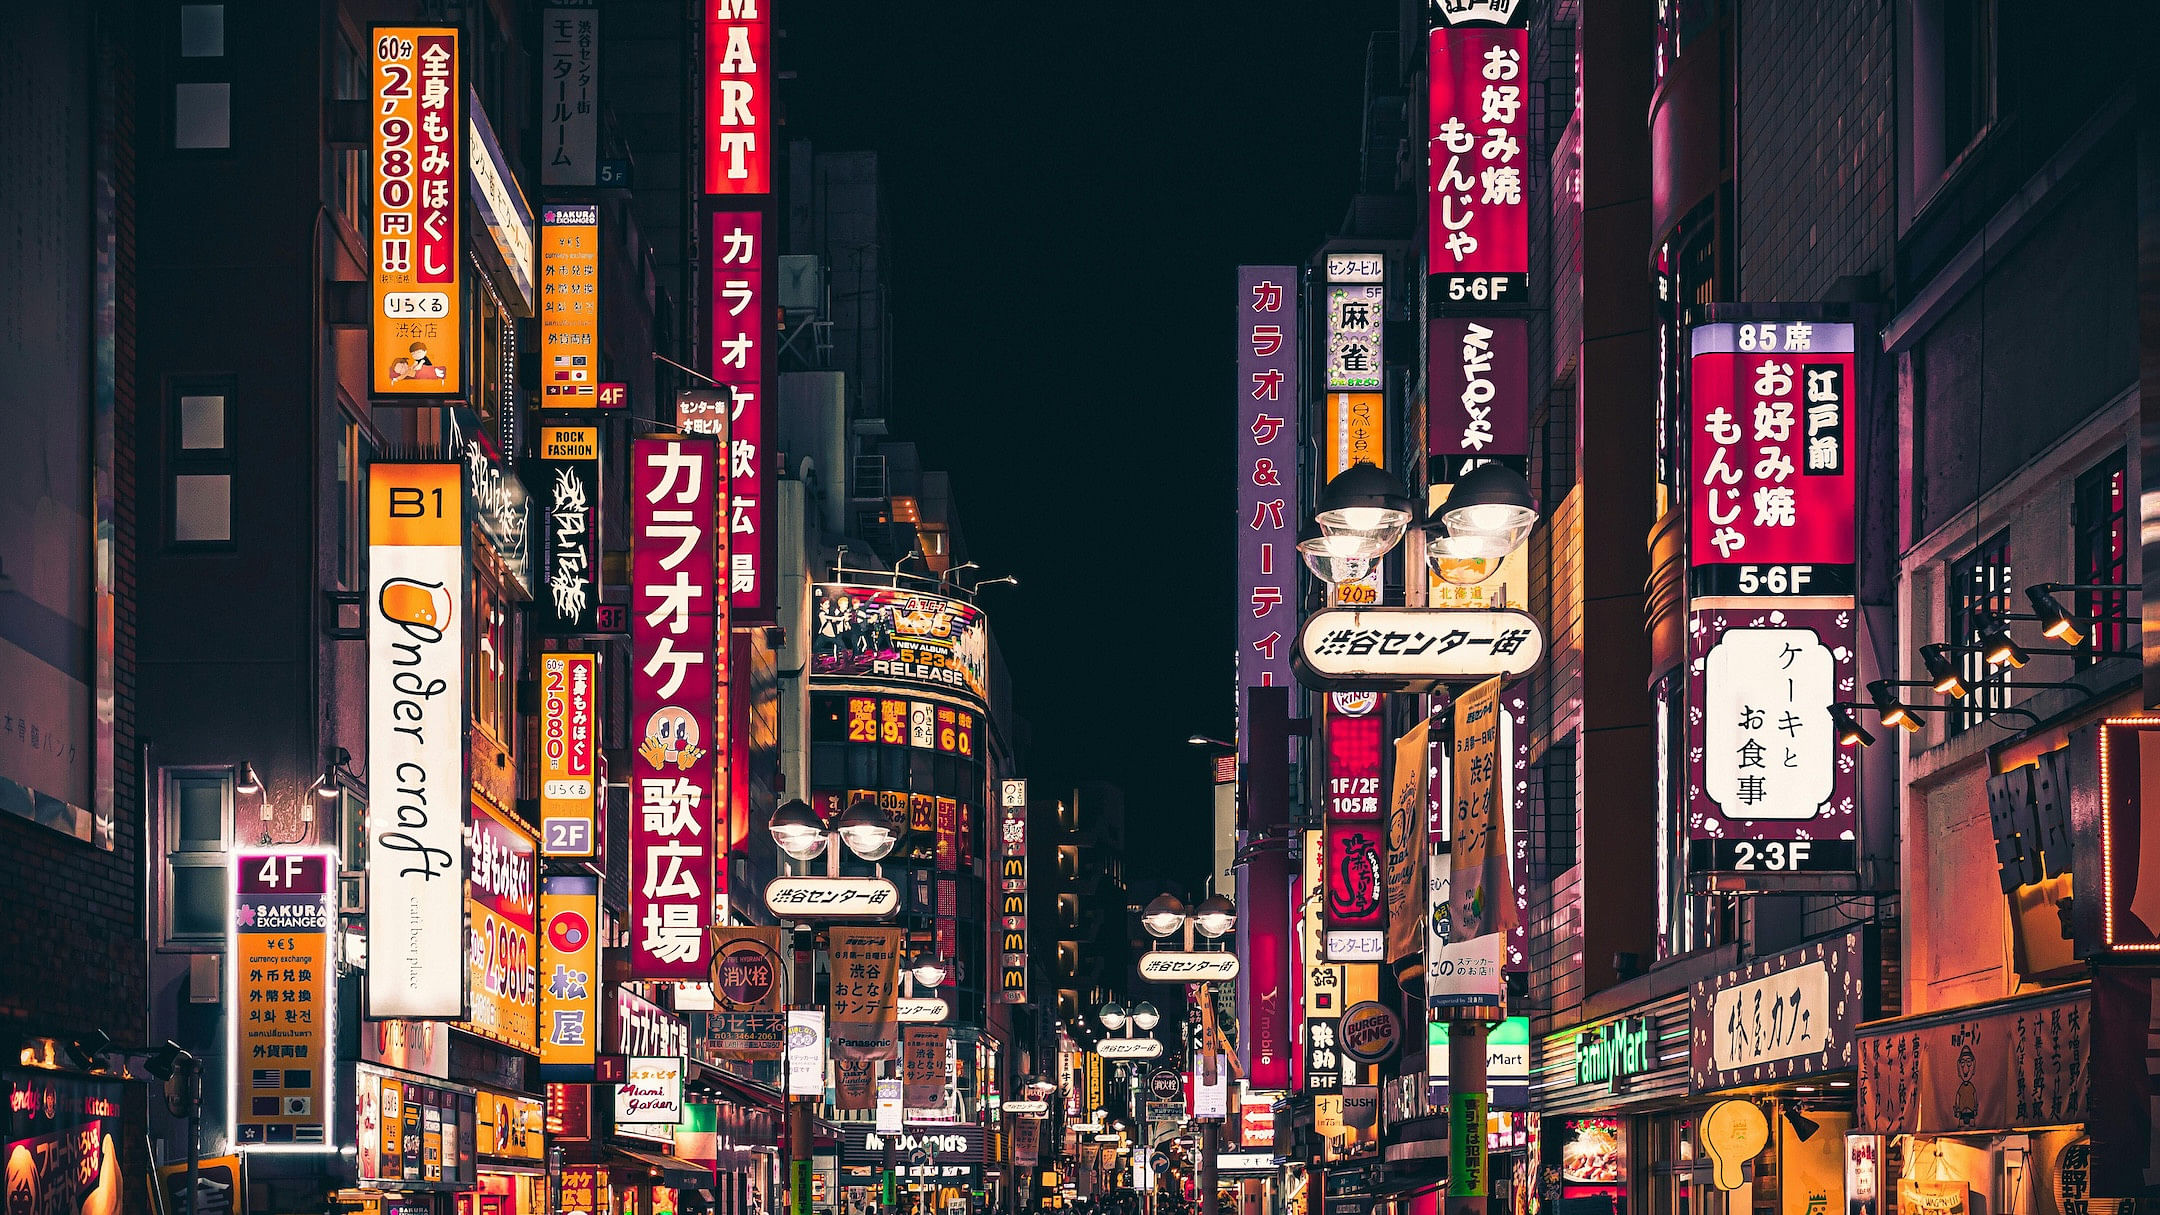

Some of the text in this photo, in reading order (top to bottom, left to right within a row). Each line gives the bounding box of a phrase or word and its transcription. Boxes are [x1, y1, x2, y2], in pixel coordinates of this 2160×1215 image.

[378, 37, 412, 60] 60分
[577, 20, 591, 115] 渋谷センター街
[551, 20, 573, 167] モニタールーム
[1481, 45, 1521, 205] お好み焼
[421, 43, 450, 274] 全身もみほぐし
[1438, 116, 1478, 262] もんじゃ
[1328, 261, 1381, 276] センタービル
[1366, 288, 1382, 298] 5F
[389, 298, 443, 313] りらくる
[395, 323, 438, 338] 渋谷店
[1341, 302, 1370, 371] 麻雀
[600, 388, 624, 404] 4F
[680, 401, 725, 414] センター街
[1808, 370, 1838, 470] 江戸前
[555, 431, 584, 443] ROCK
[1753, 360, 1795, 527] お好み焼
[548, 445, 592, 456] FASHION
[1703, 407, 1746, 558] もんじゃ
[389, 488, 442, 518] B1
[1439, 587, 1483, 600] 北海道
[602, 610, 622, 628] 3F
[897, 641, 948, 654] NEW ALBUM
[1314, 629, 1532, 656] 渋谷センター街
[901, 650, 945, 666] 5.23
[873, 660, 963, 686] RELEASE
[1778, 642, 1803, 768] ケーキと
[572, 663, 588, 771] 全身もみほぐし
[1736, 705, 1767, 805] お食事
[548, 784, 587, 795] りらくる
[1330, 778, 1379, 794] 1F/2F
[1333, 798, 1378, 813] 105席
[379, 762, 452, 881] craft
[551, 825, 584, 847] 2F
[258, 856, 304, 888] 4F
[471, 819, 534, 915] 全身もみほぐし
[772, 889, 890, 905] 渋谷センター街
[257, 905, 326, 917] SAKURA
[257, 917, 317, 927] EXCHANGE
[1328, 937, 1382, 952] センタービル
[250, 956, 312, 965] currency exchange
[1146, 960, 1236, 972] 渋谷センター街
[724, 965, 769, 987] 消火栓
[850, 964, 881, 979] 渋谷
[835, 982, 893, 997] おとなり
[549, 964, 588, 1046] 松屋
[835, 1000, 894, 1015] サンデー
[1347, 1015, 1390, 1034] BURGER
[839, 1038, 891, 1048] Panasonic
[1350, 1024, 1392, 1050] KING
[253, 1045, 308, 1058] 外貨両替
[1575, 1017, 1648, 1094] FamilyMart
[1310, 1076, 1337, 1088] B1F
[617, 1085, 664, 1096] Miami
[85, 1096, 120, 1117] Kitchen
[626, 1099, 678, 1116] Garden
[1317, 1098, 1343, 1114] すし
[1344, 1098, 1376, 1107] SUSHI
